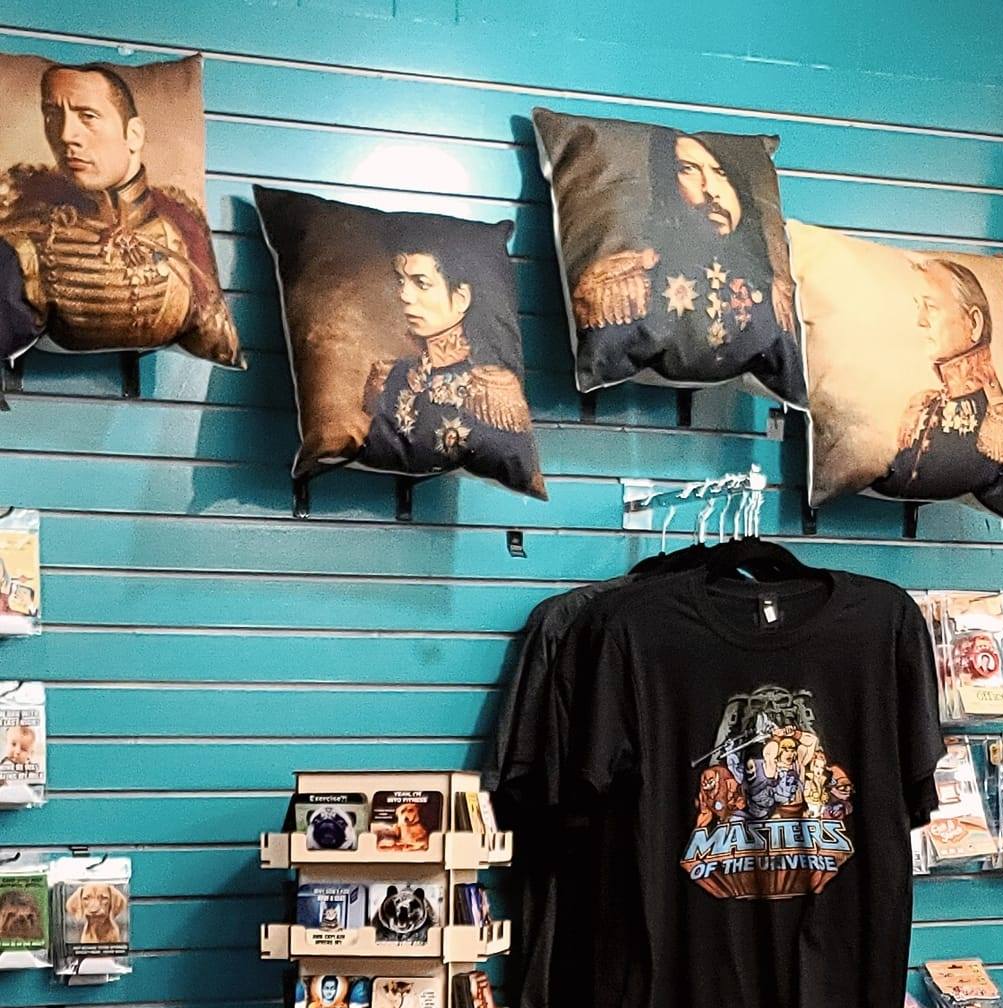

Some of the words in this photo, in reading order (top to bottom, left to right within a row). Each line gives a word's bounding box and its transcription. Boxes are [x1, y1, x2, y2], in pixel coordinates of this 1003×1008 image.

[683, 818, 855, 860] MASTERS
[690, 861, 718, 880] OF
[723, 857, 754, 875] THE
